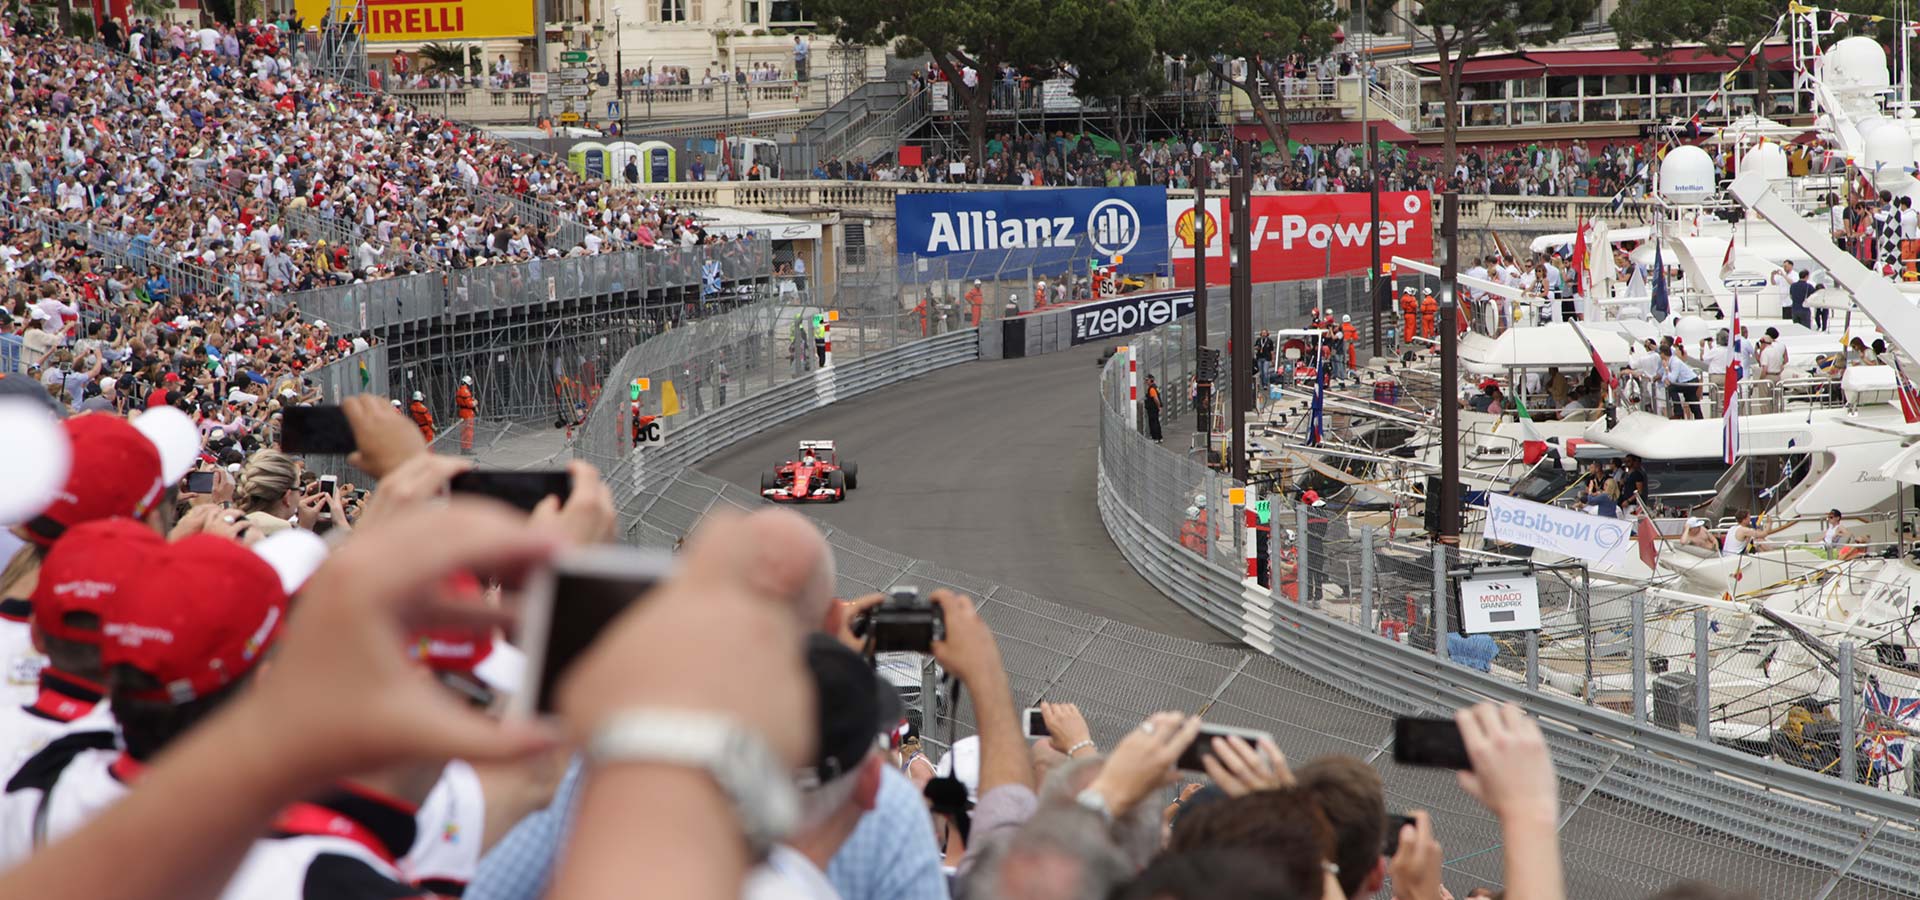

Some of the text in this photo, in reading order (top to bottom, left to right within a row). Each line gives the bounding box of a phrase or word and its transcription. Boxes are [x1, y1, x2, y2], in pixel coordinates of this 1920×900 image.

[926, 210, 1076, 252] Allianz
[1250, 214, 1414, 250] V-Power
[1101, 280, 1114, 294] SC
[1085, 297, 1194, 335] zepter
[1479, 592, 1522, 603] MONACO
